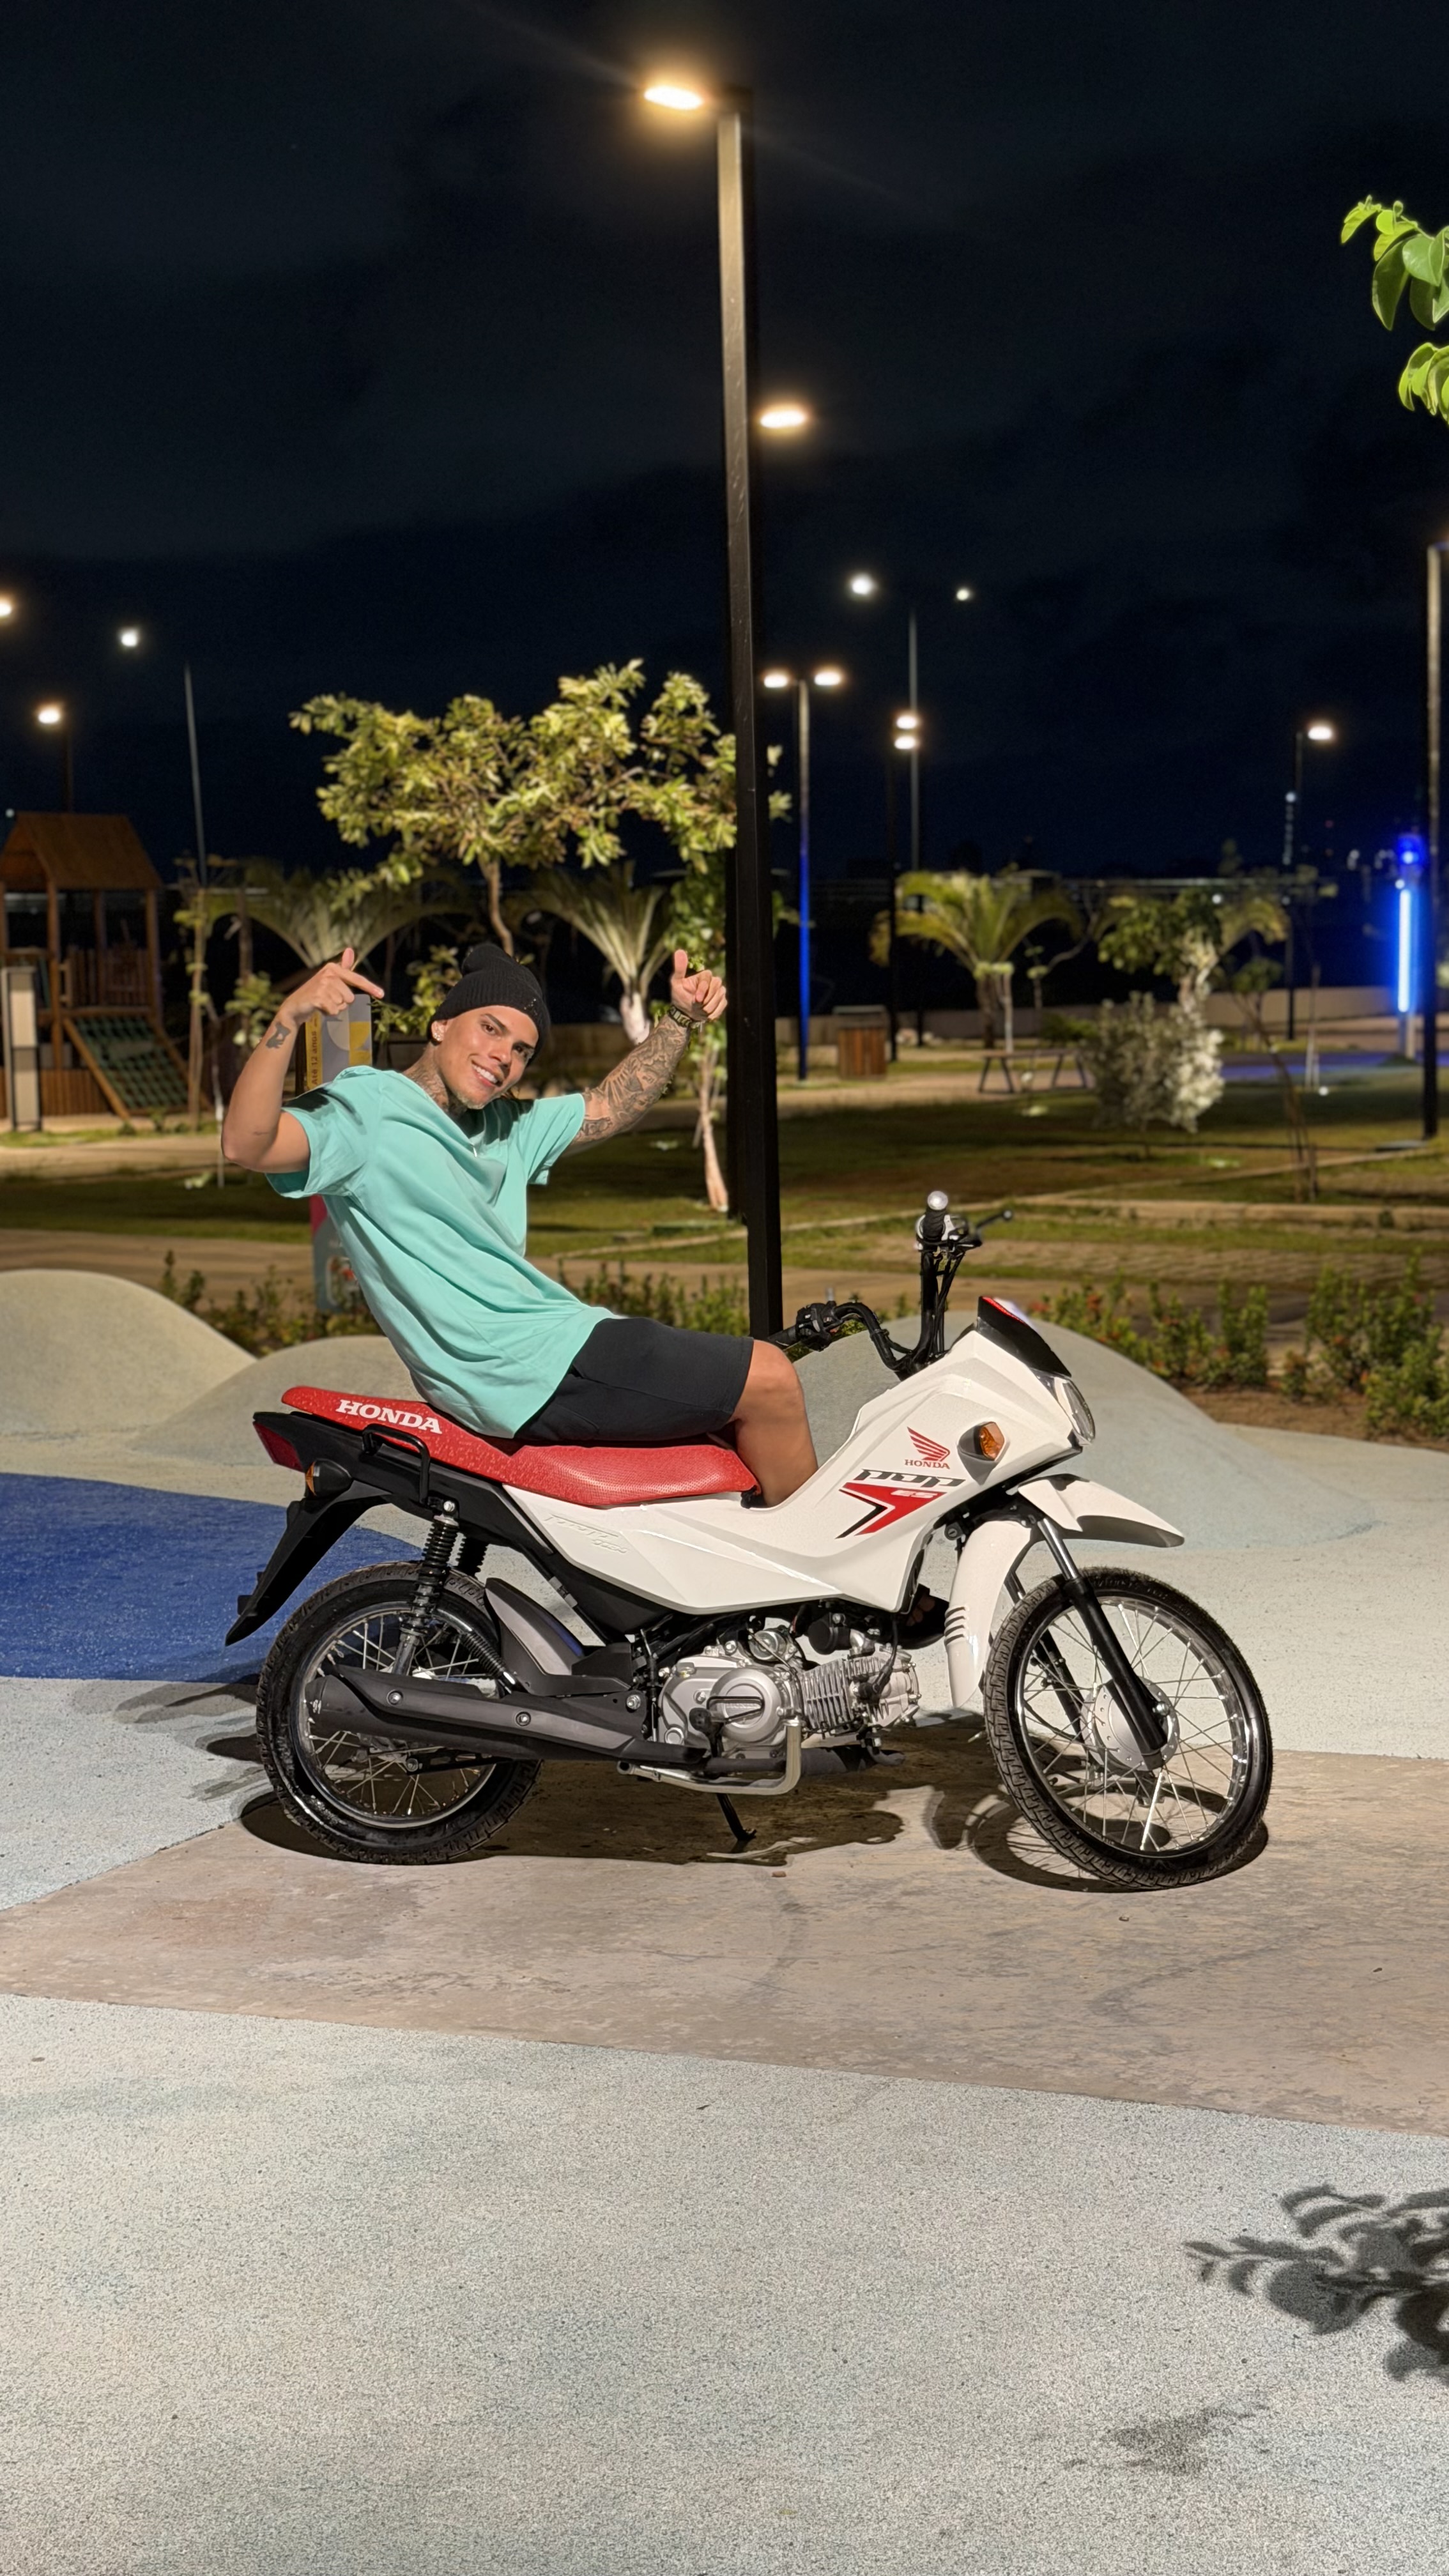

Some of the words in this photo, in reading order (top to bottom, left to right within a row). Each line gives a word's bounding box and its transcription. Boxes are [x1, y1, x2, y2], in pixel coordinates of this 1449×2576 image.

[310, 1057, 318, 1066] 12
[336, 1400, 442, 1434] HONDA
[904, 1459, 951, 1469] HONDA
[891, 1489, 939, 1499] ES
